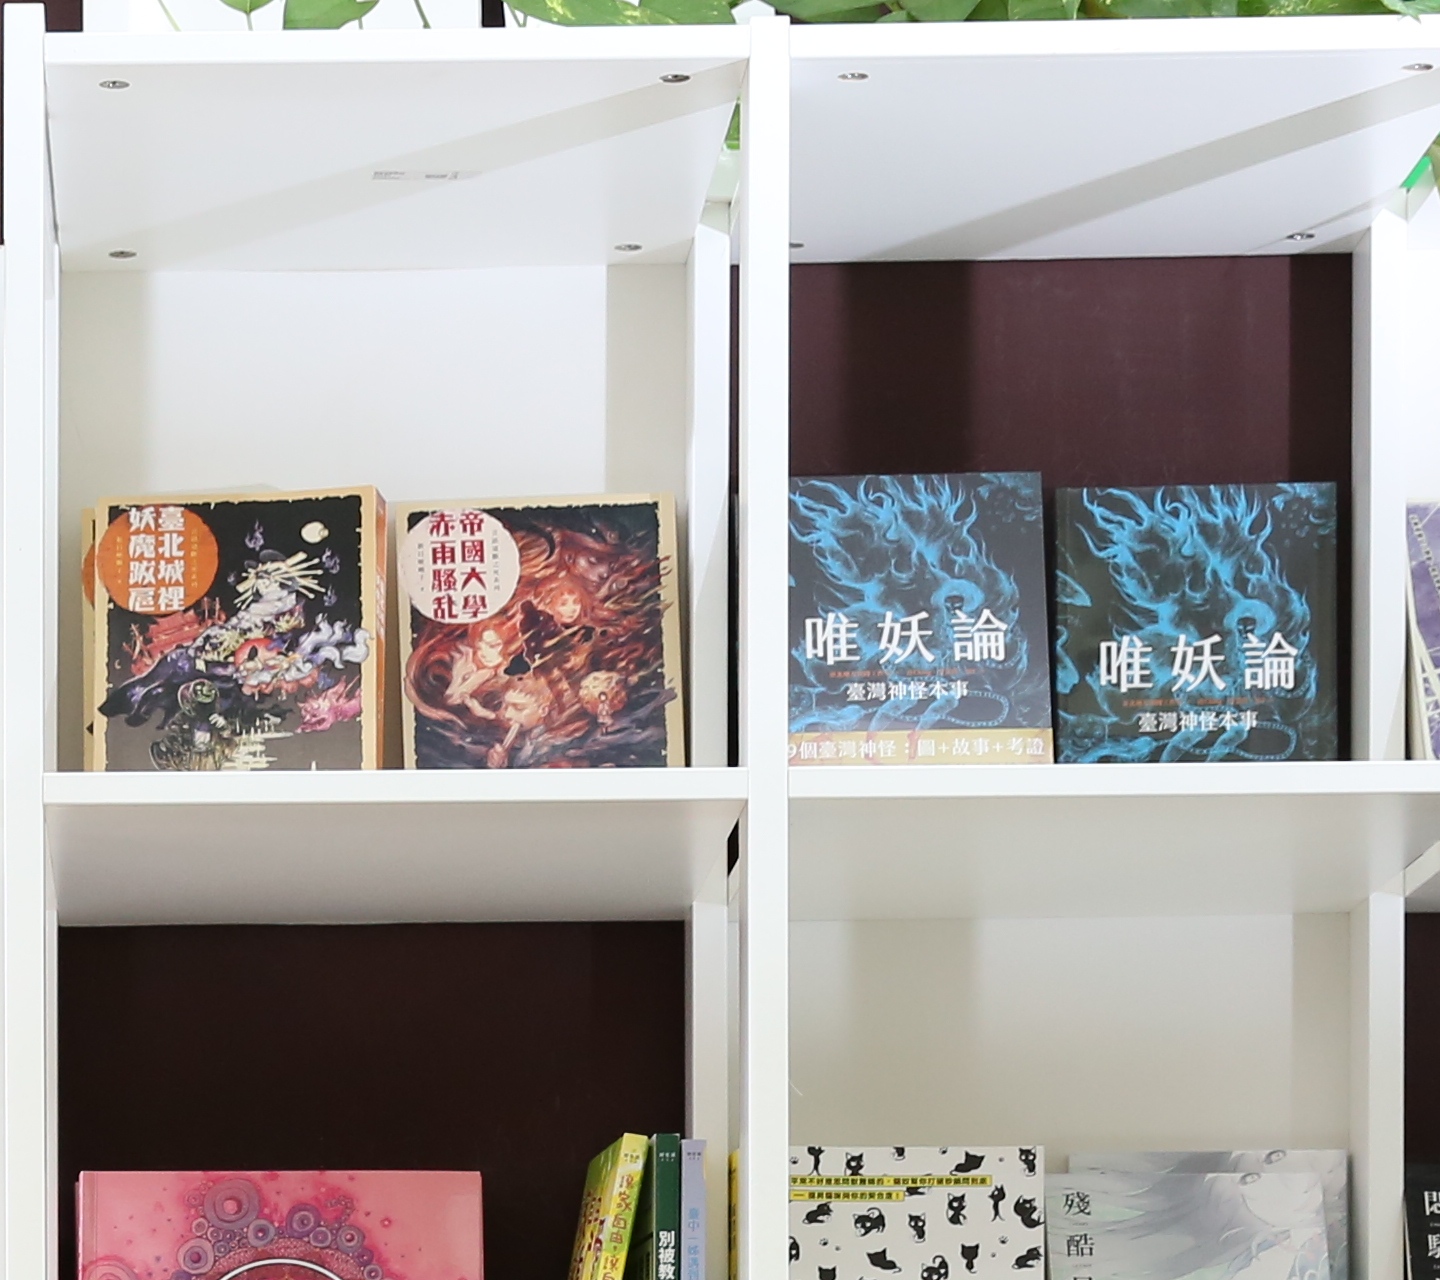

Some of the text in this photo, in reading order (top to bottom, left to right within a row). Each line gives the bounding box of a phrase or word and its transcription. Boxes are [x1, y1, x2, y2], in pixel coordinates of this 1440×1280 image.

[127, 506, 157, 614] 妖魔跋扈
[157, 506, 186, 613] 臺北城裡
[459, 510, 489, 619] 帝國大學
[804, 608, 1009, 666] 唯妖論
[1098, 632, 1299, 694] 唯妖論
[846, 680, 970, 702] 臺灣神怪本事
[1137, 709, 1259, 733] 臺灣神怪本事
